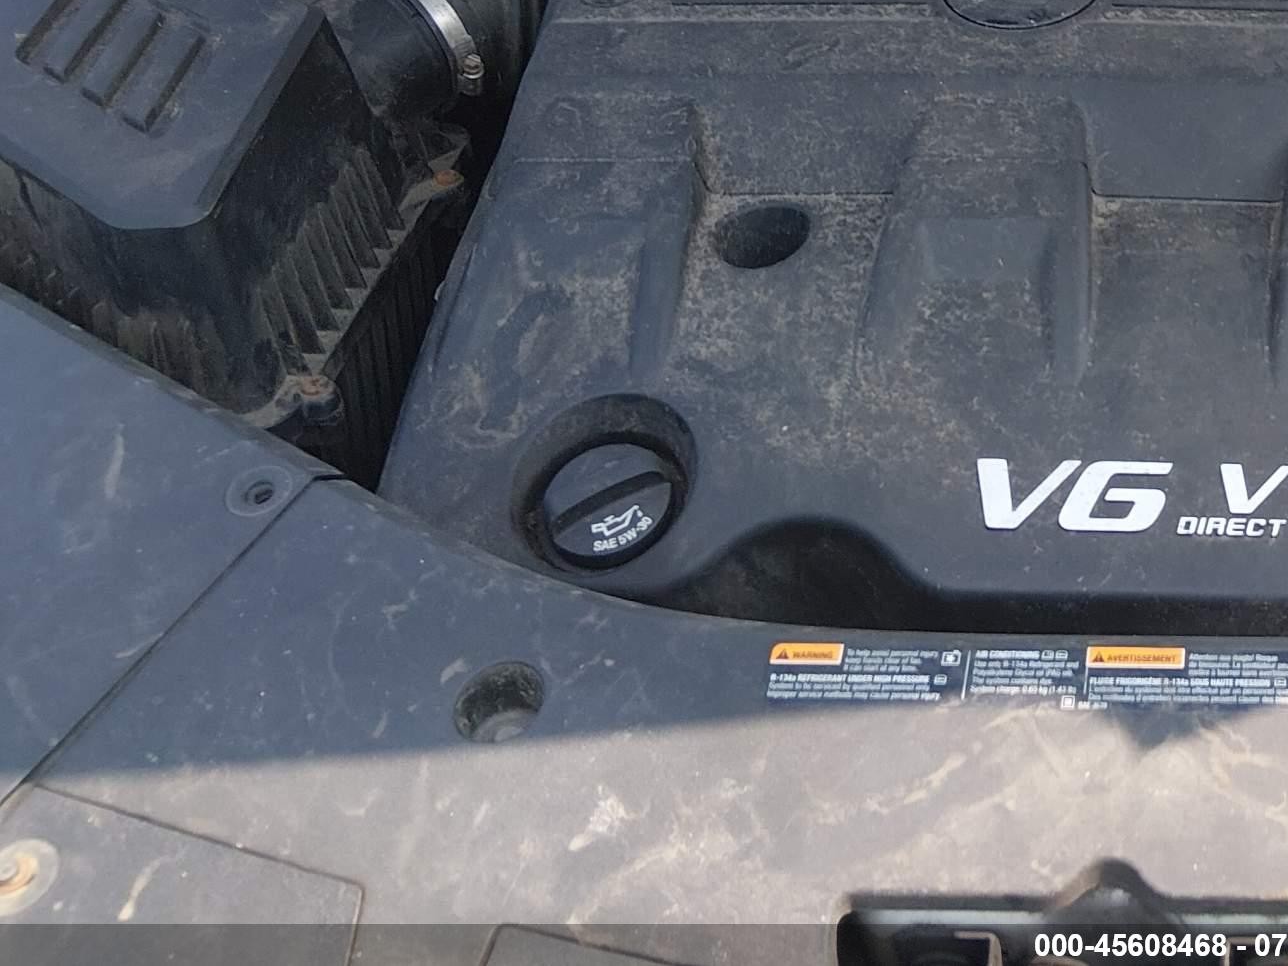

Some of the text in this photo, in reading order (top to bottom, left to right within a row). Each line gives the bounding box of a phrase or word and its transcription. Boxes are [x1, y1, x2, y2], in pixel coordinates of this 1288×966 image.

[976, 458, 1174, 533] V6
[1176, 516, 1287, 539] DIRECT
[592, 516, 654, 552] SAE 5W-30
[792, 650, 833, 659] WARNING
[976, 650, 1040, 659] AIR CONDITIONING
[1107, 654, 1177, 664] AVERTISSEMENT
[797, 674, 846, 682] REFRIGERANT
[848, 674, 873, 682] UNDER
[874, 674, 891, 682] HIGH
[892, 675, 930, 683] PRESSURE
[1211, 678, 1233, 686] HAUTE
